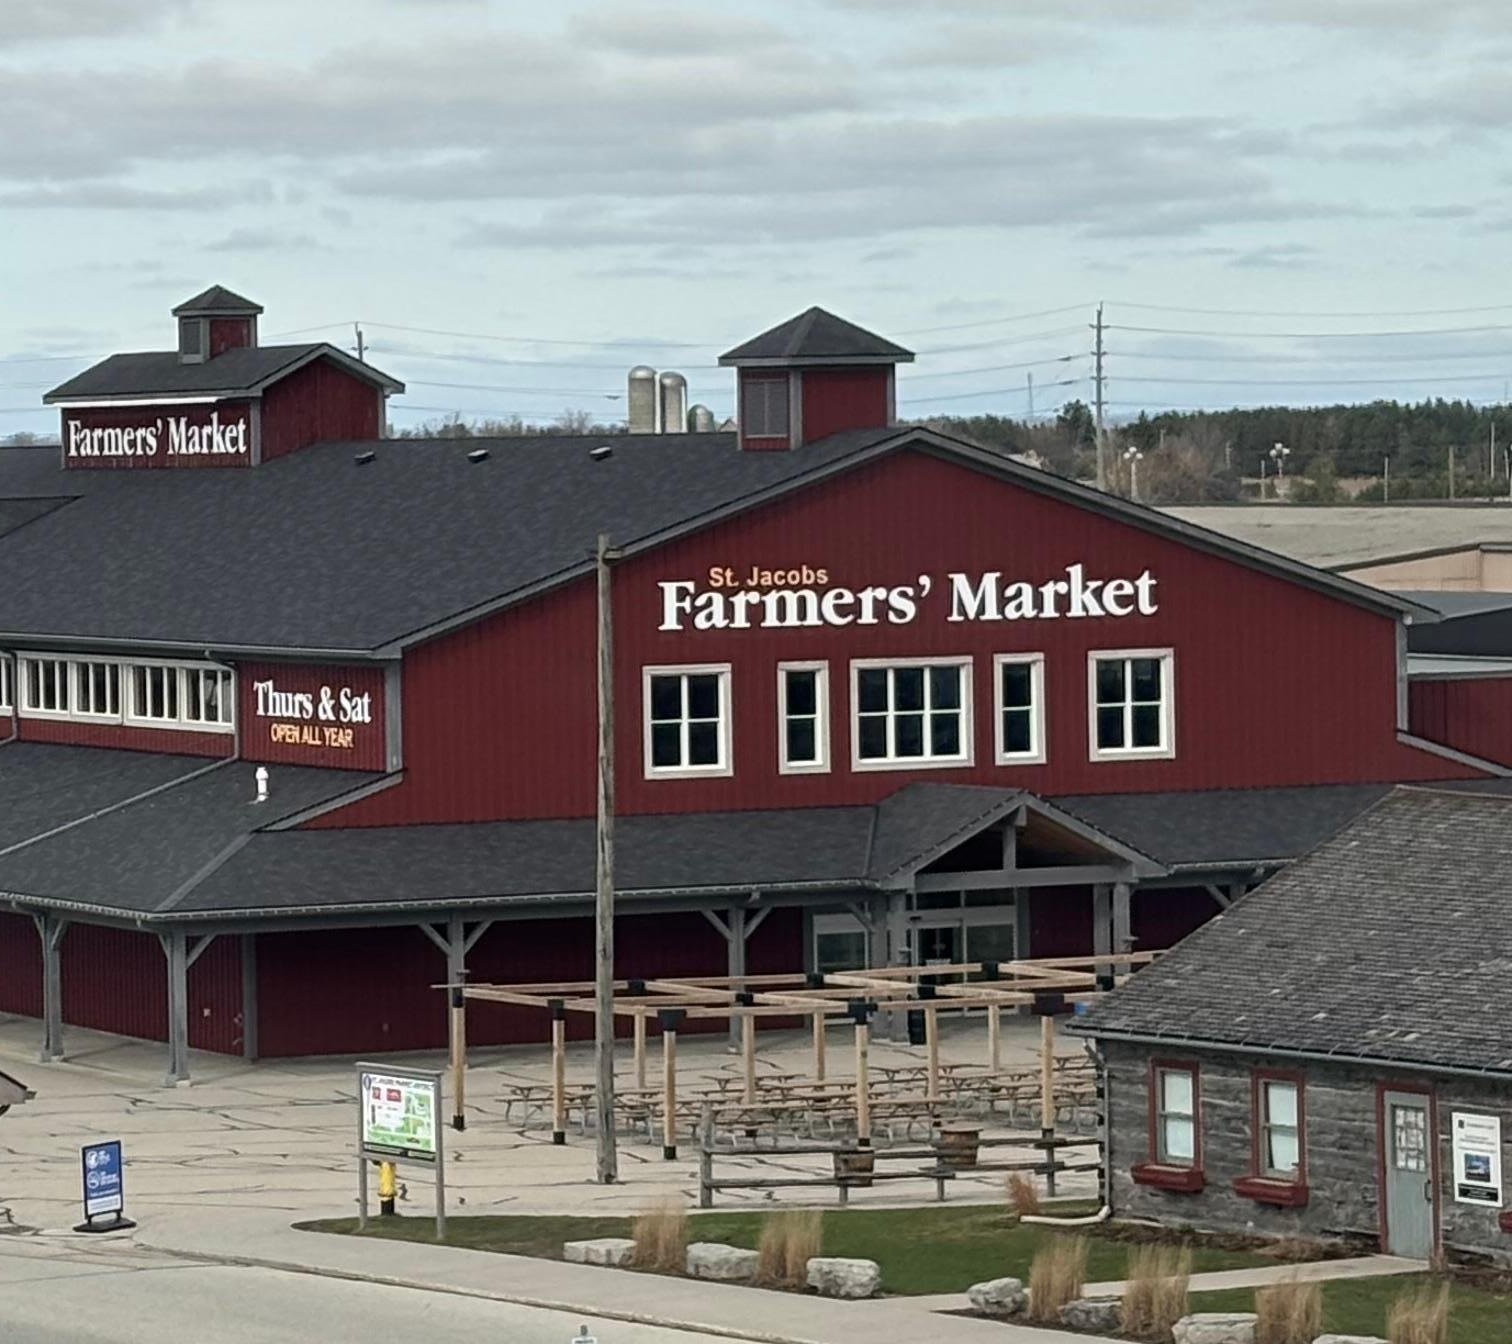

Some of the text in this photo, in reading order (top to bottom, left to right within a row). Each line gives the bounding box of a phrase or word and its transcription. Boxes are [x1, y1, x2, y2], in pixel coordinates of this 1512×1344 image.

[67, 411, 247, 457] Farmers' Market
[657, 564, 1159, 631] Farmers' Market
[708, 565, 829, 587] St. Jacobs
[253, 679, 372, 724] Thurs & Sat
[270, 723, 355, 749] OPEN ALL YEAR
